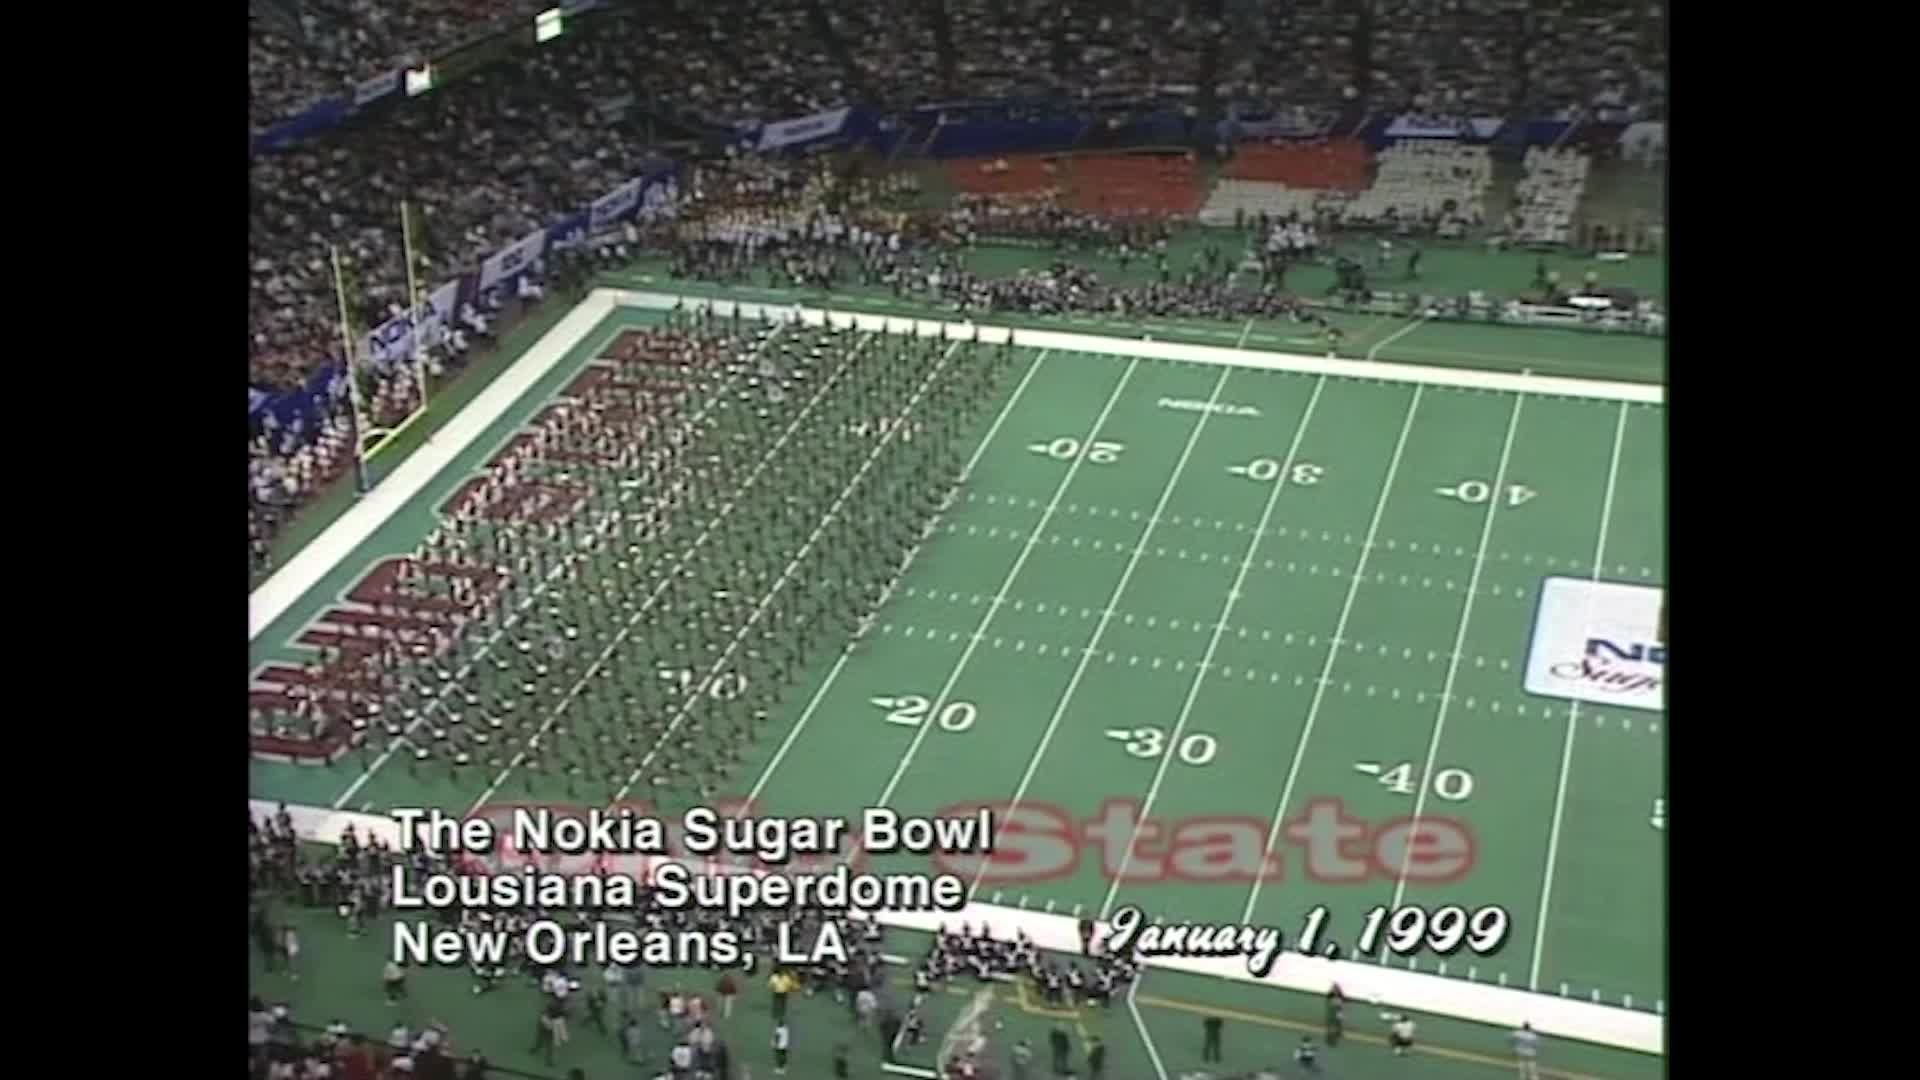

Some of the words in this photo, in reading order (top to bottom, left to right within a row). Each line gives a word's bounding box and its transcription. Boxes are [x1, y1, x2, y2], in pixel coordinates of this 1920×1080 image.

[885, 695, 977, 732] 20
[1125, 717, 1217, 764] 30
[1379, 762, 1474, 800] 40
